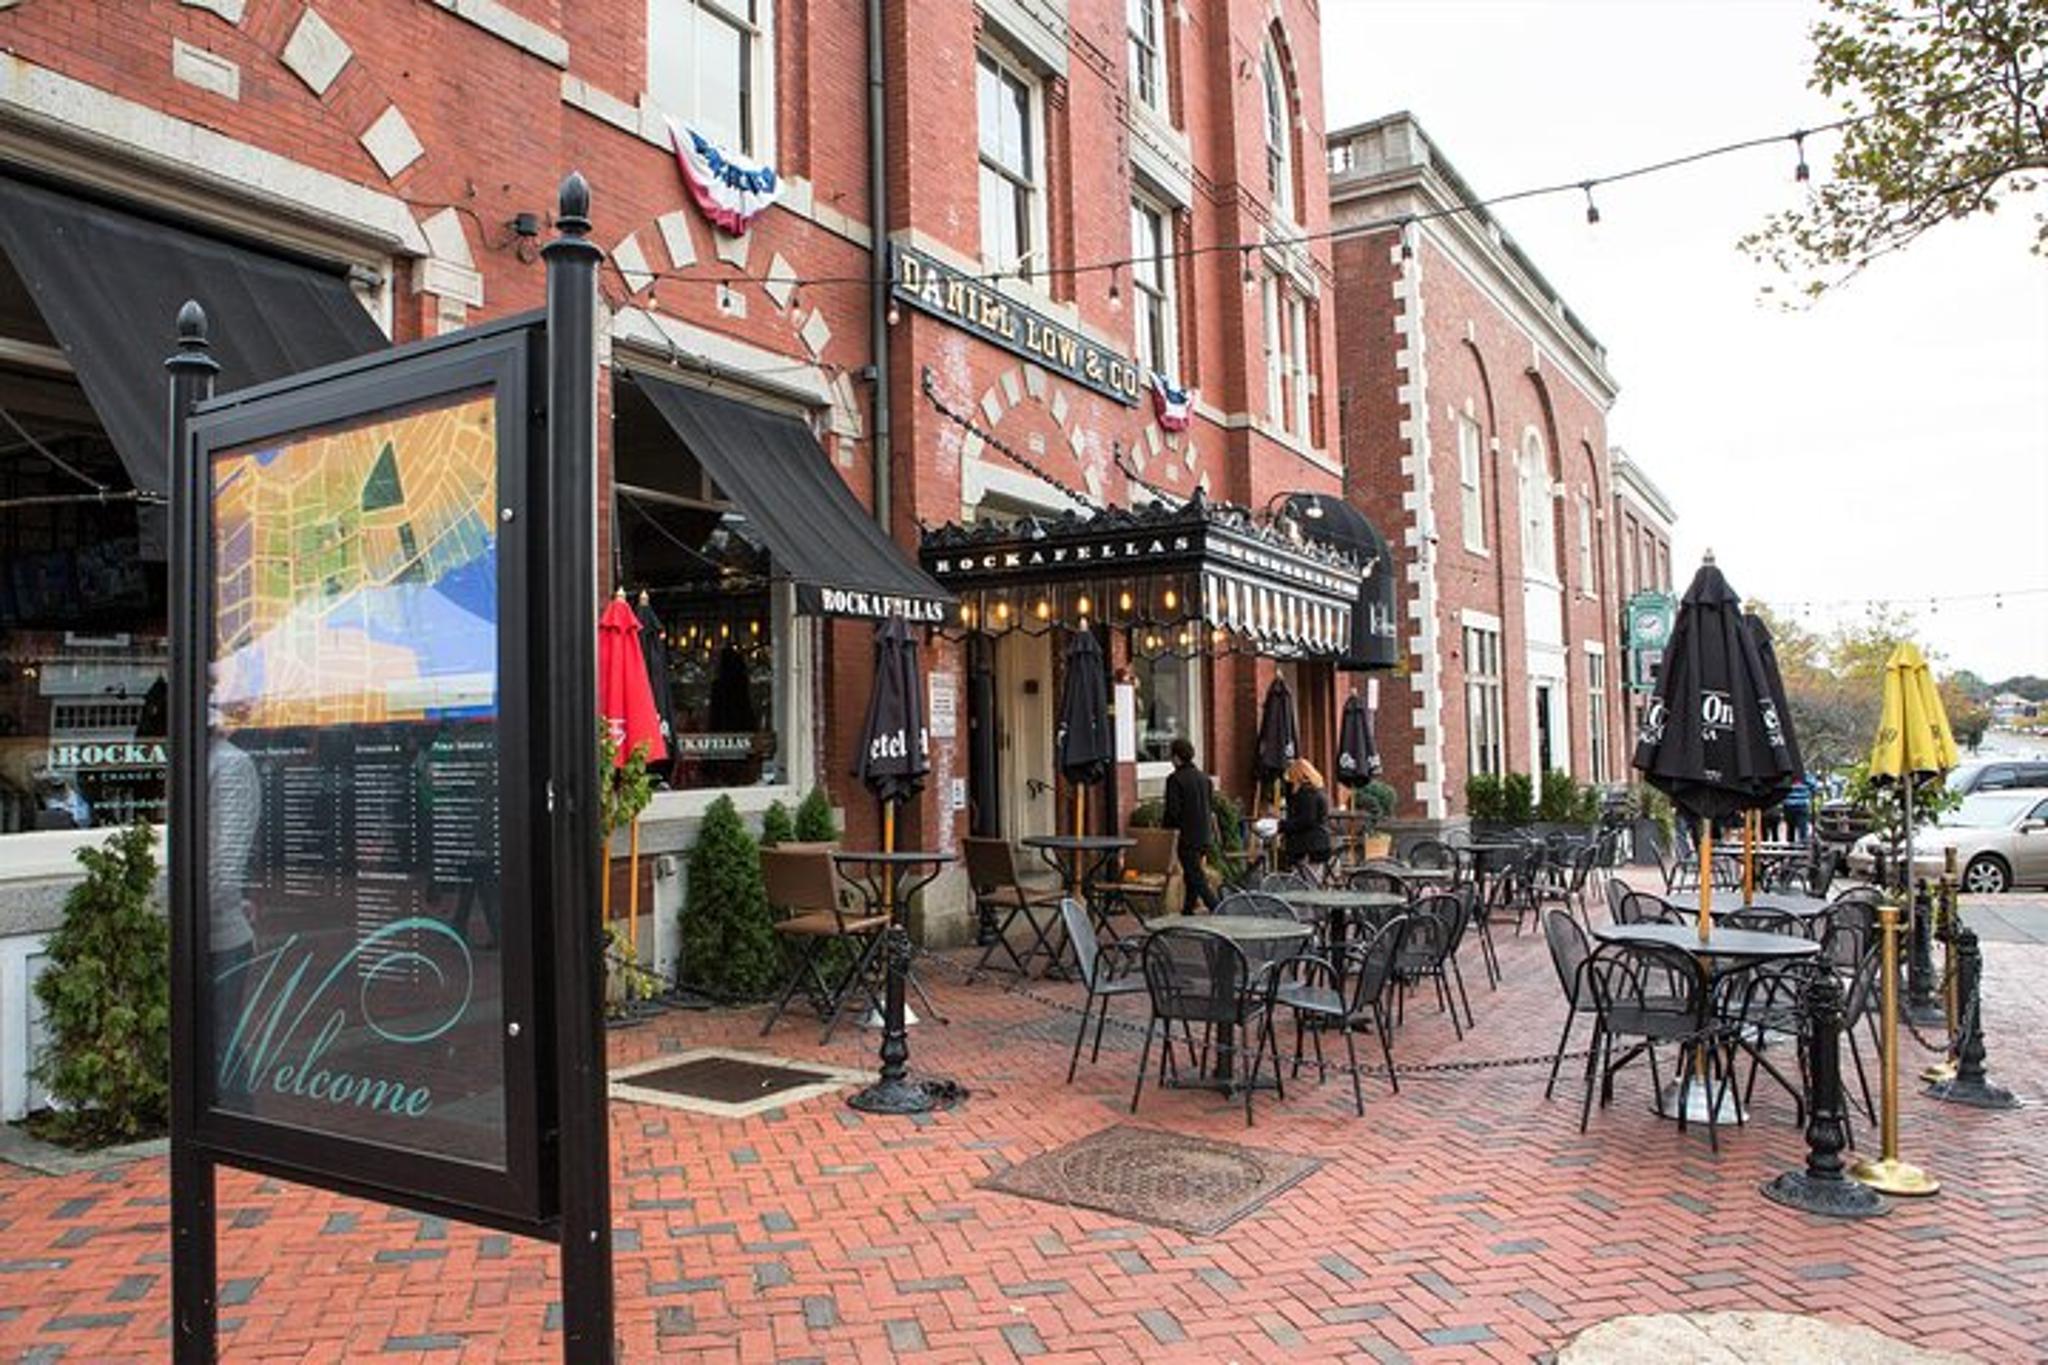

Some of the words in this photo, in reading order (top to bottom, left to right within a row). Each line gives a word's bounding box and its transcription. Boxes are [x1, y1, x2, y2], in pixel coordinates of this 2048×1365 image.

[901, 253, 1014, 341] DANIEL
[1025, 316, 1078, 369] LOW
[1084, 348, 1103, 383] &
[936, 536, 1188, 573] ROCKAFELLAS
[821, 586, 943, 621] ROCKAFELLAS
[56, 744, 168, 765] ROCKA
[214, 918, 474, 1117] Welcome
